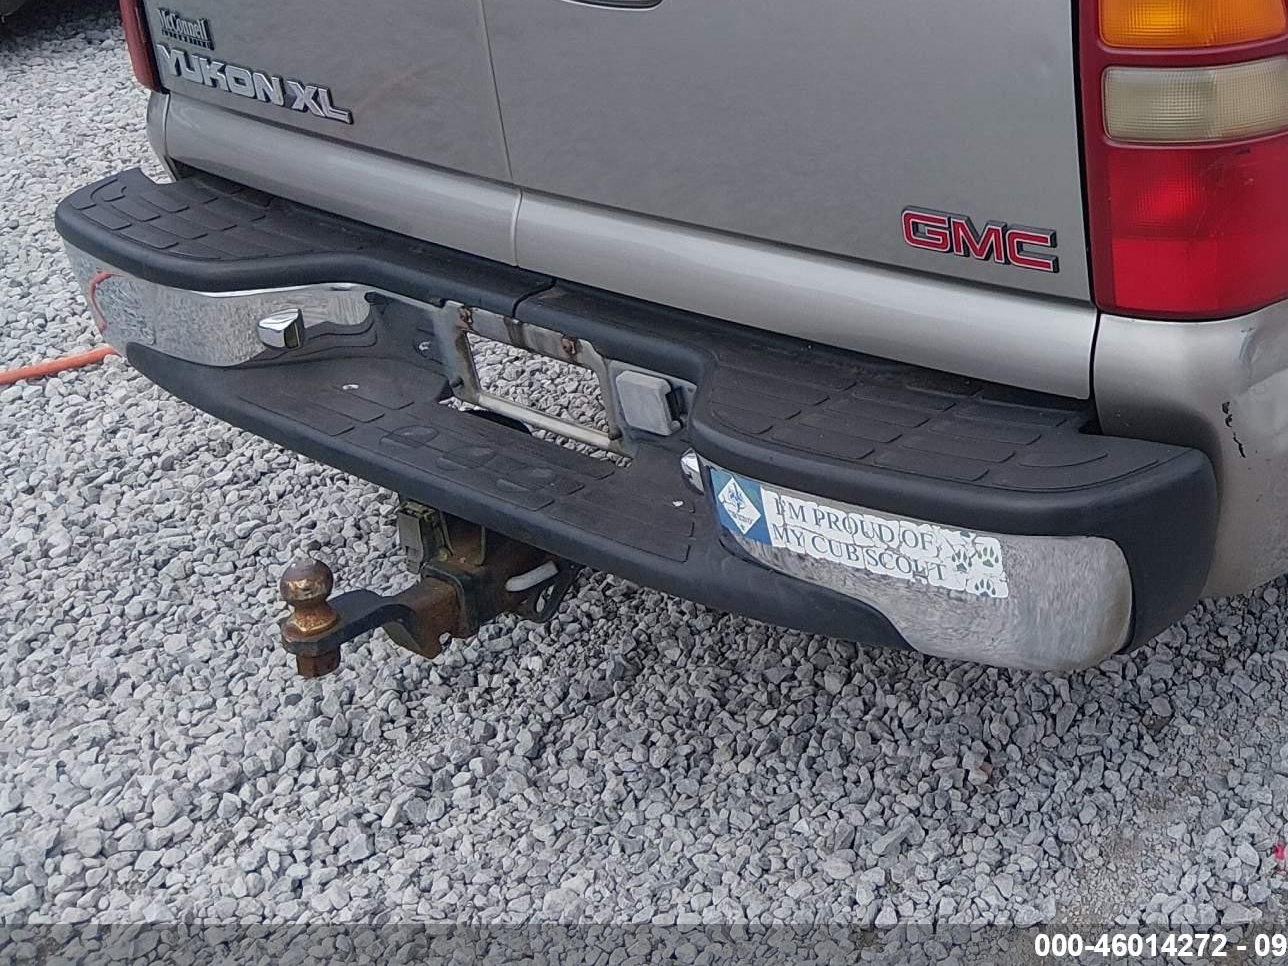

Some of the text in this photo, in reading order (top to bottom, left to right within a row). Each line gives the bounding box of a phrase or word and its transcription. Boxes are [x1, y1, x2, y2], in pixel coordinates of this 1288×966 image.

[156, 43, 354, 125] YUKON XL
[901, 205, 1060, 274] GMC
[771, 523, 948, 581] MY CUB SCOUT
[774, 496, 807, 524] I'M
[811, 508, 895, 545] PROUD
[901, 528, 934, 551] OF
